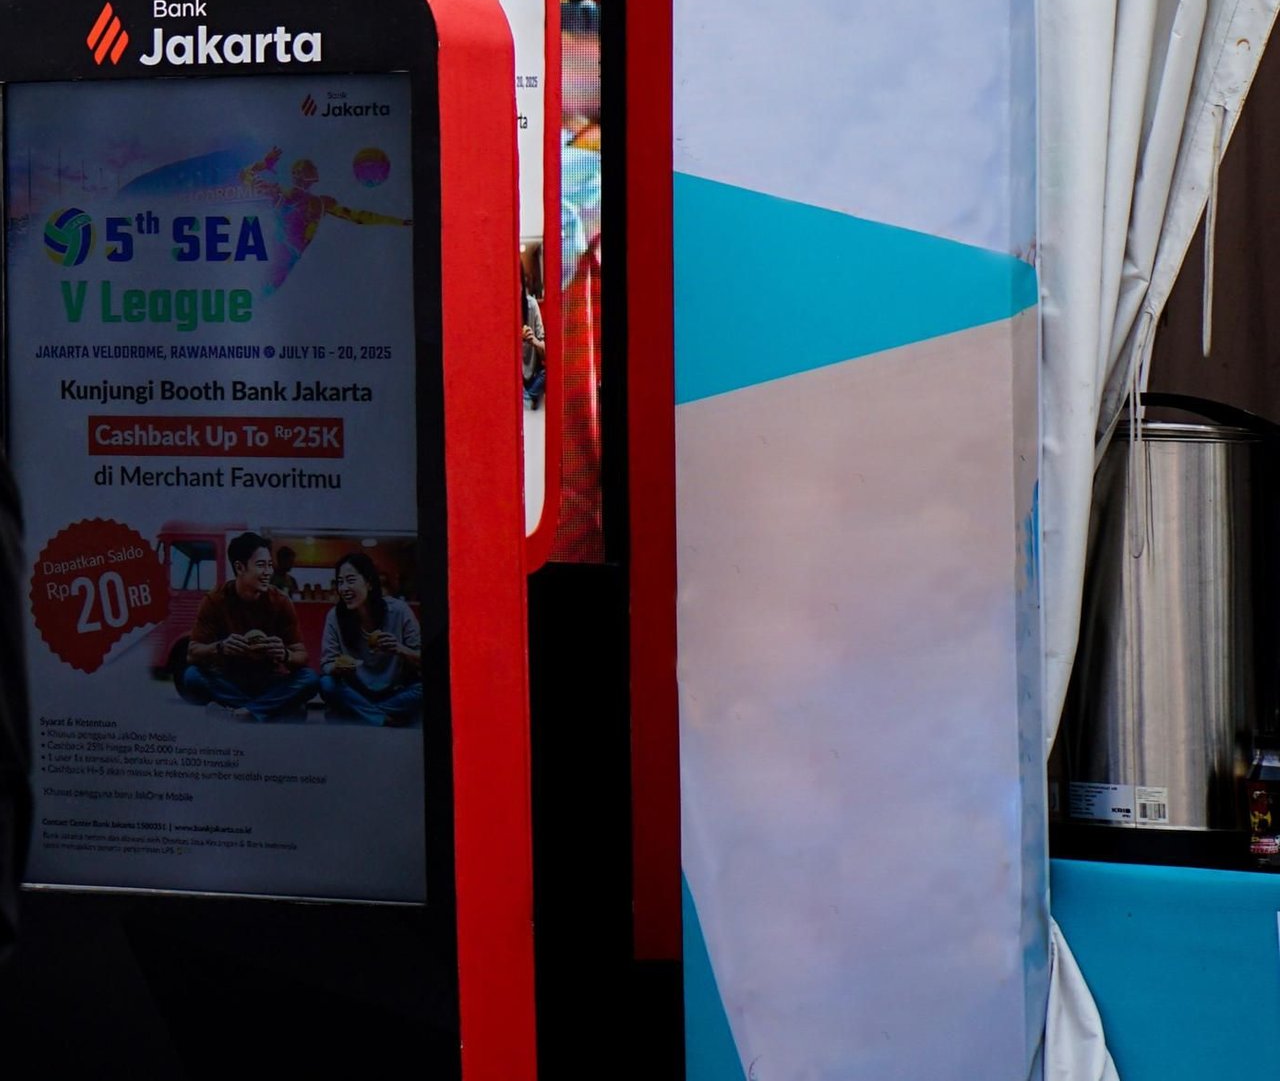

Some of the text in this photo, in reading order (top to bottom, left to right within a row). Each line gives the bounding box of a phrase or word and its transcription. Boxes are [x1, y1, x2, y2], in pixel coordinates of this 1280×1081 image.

[139, 25, 323, 66] Jakarta
[322, 102, 390, 118] Jakarta
[105, 211, 268, 262] 5th SEA
[61, 280, 252, 332] V League
[35, 346, 89, 359] JAKARTA
[93, 346, 167, 360] VELODROME,
[171, 346, 260, 359] RAWAMANGUN
[279, 346, 308, 359] JULY
[312, 346, 325, 359] 16
[338, 346, 357, 361] 20,
[360, 347, 391, 360] 2025
[60, 380, 372, 404] Kunjungi Booth Bank Jakarta
[94, 424, 200, 447] Cashback
[206, 426, 238, 450] Up
[241, 426, 269, 447] To
[94, 466, 341, 489] di Merchant Favoritmu
[43, 545, 144, 575] Dapatkan Saldo
